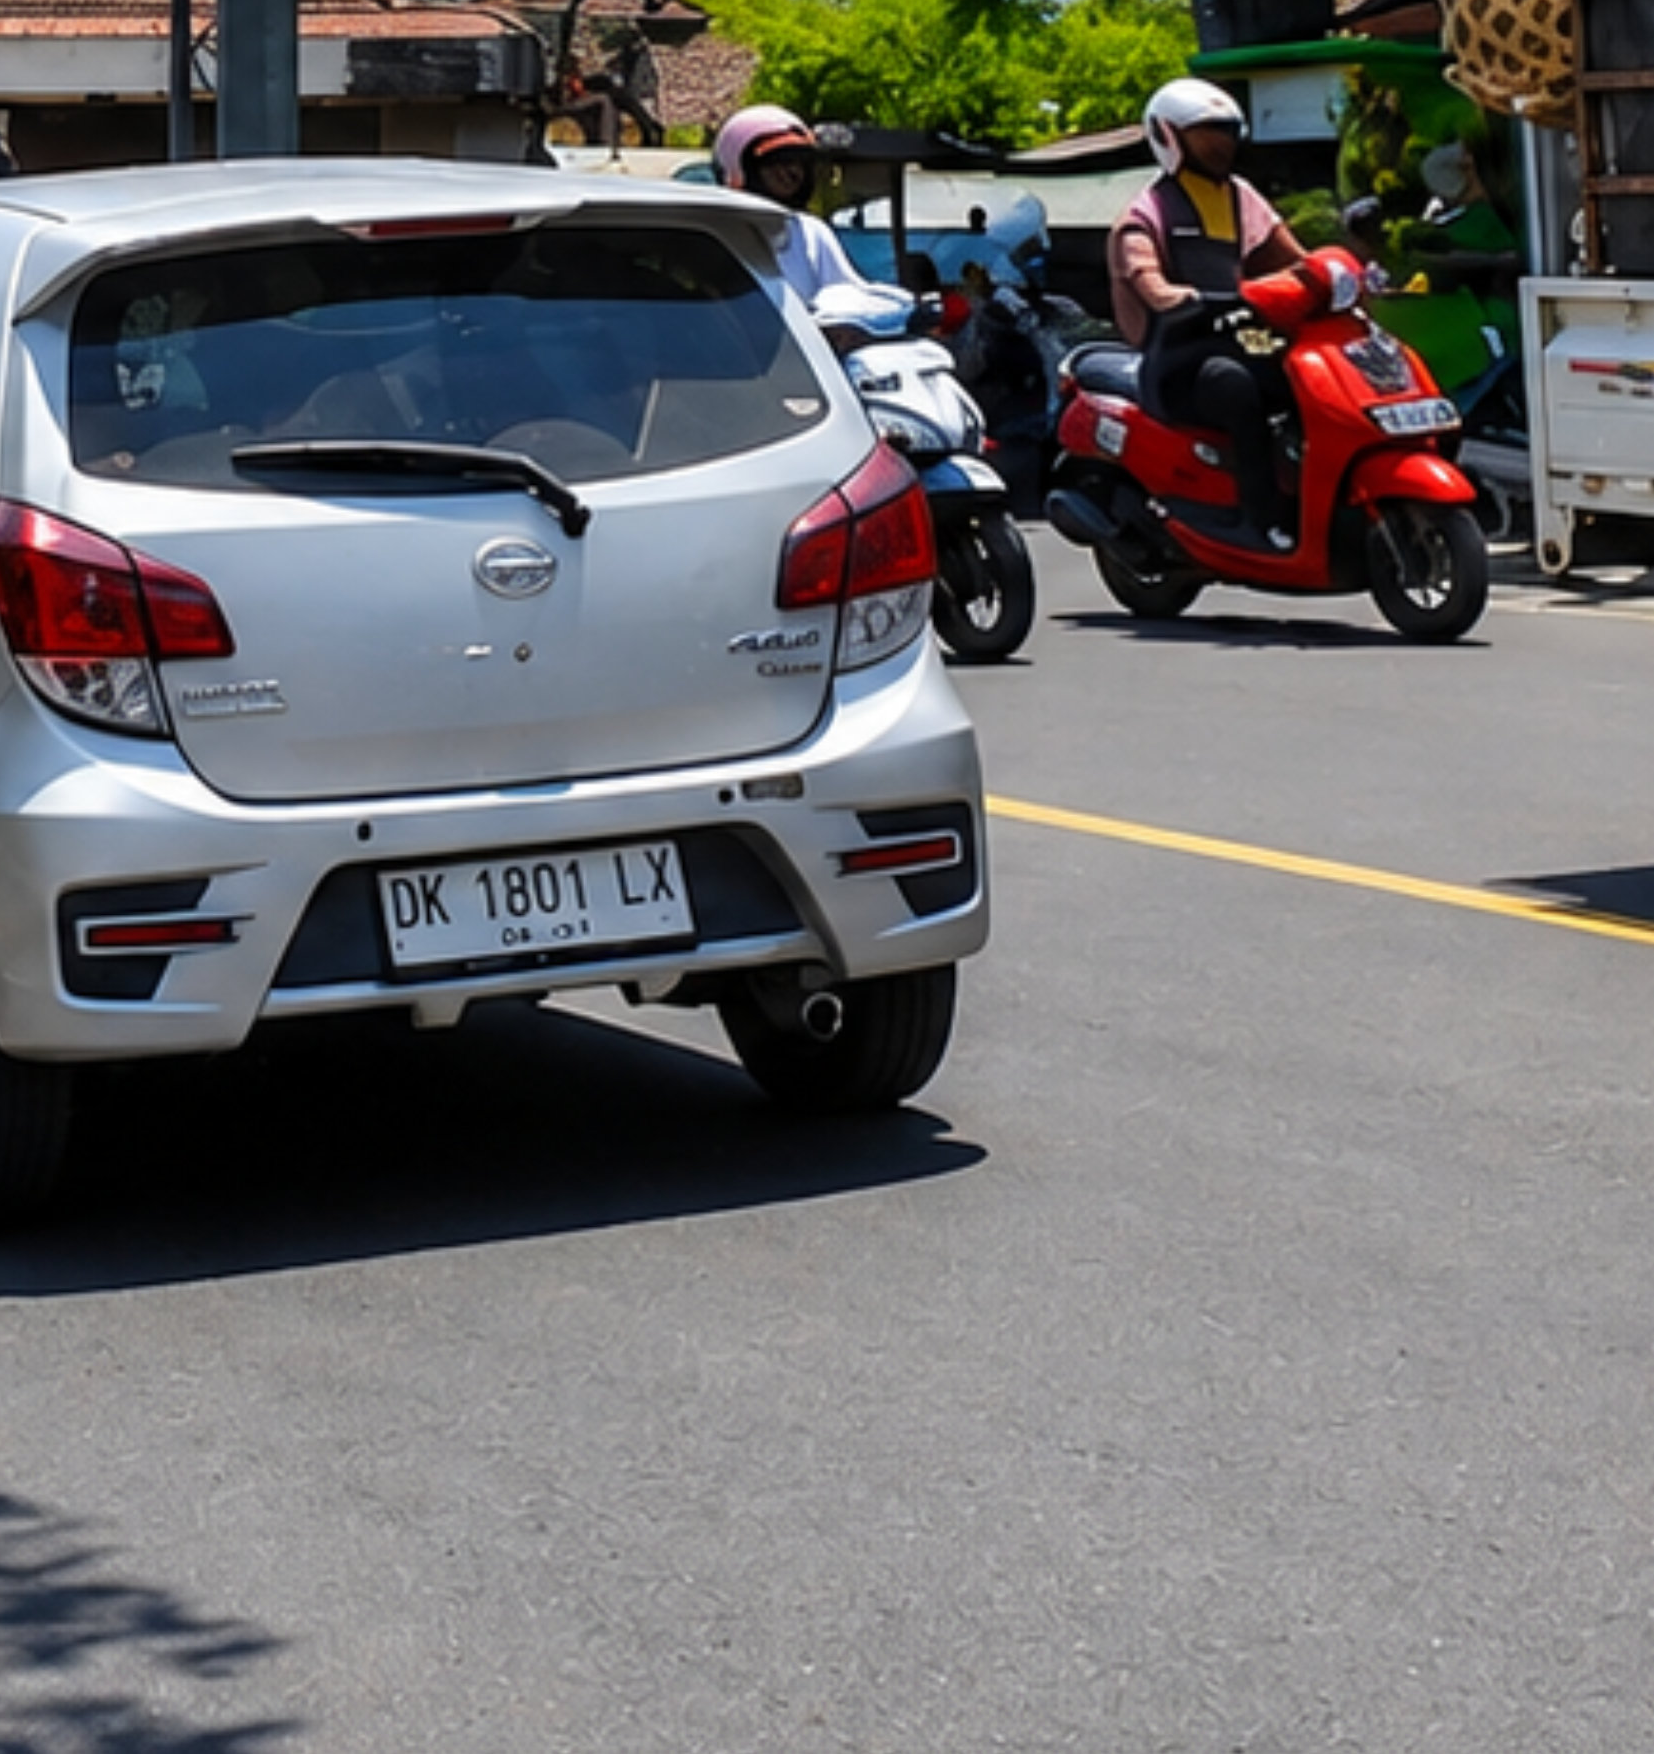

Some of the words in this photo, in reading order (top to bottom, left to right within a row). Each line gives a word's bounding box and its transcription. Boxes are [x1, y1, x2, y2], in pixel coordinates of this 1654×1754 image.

[391, 874, 450, 929] DK
[477, 858, 587, 920] 1801
[613, 848, 677, 906] LX
